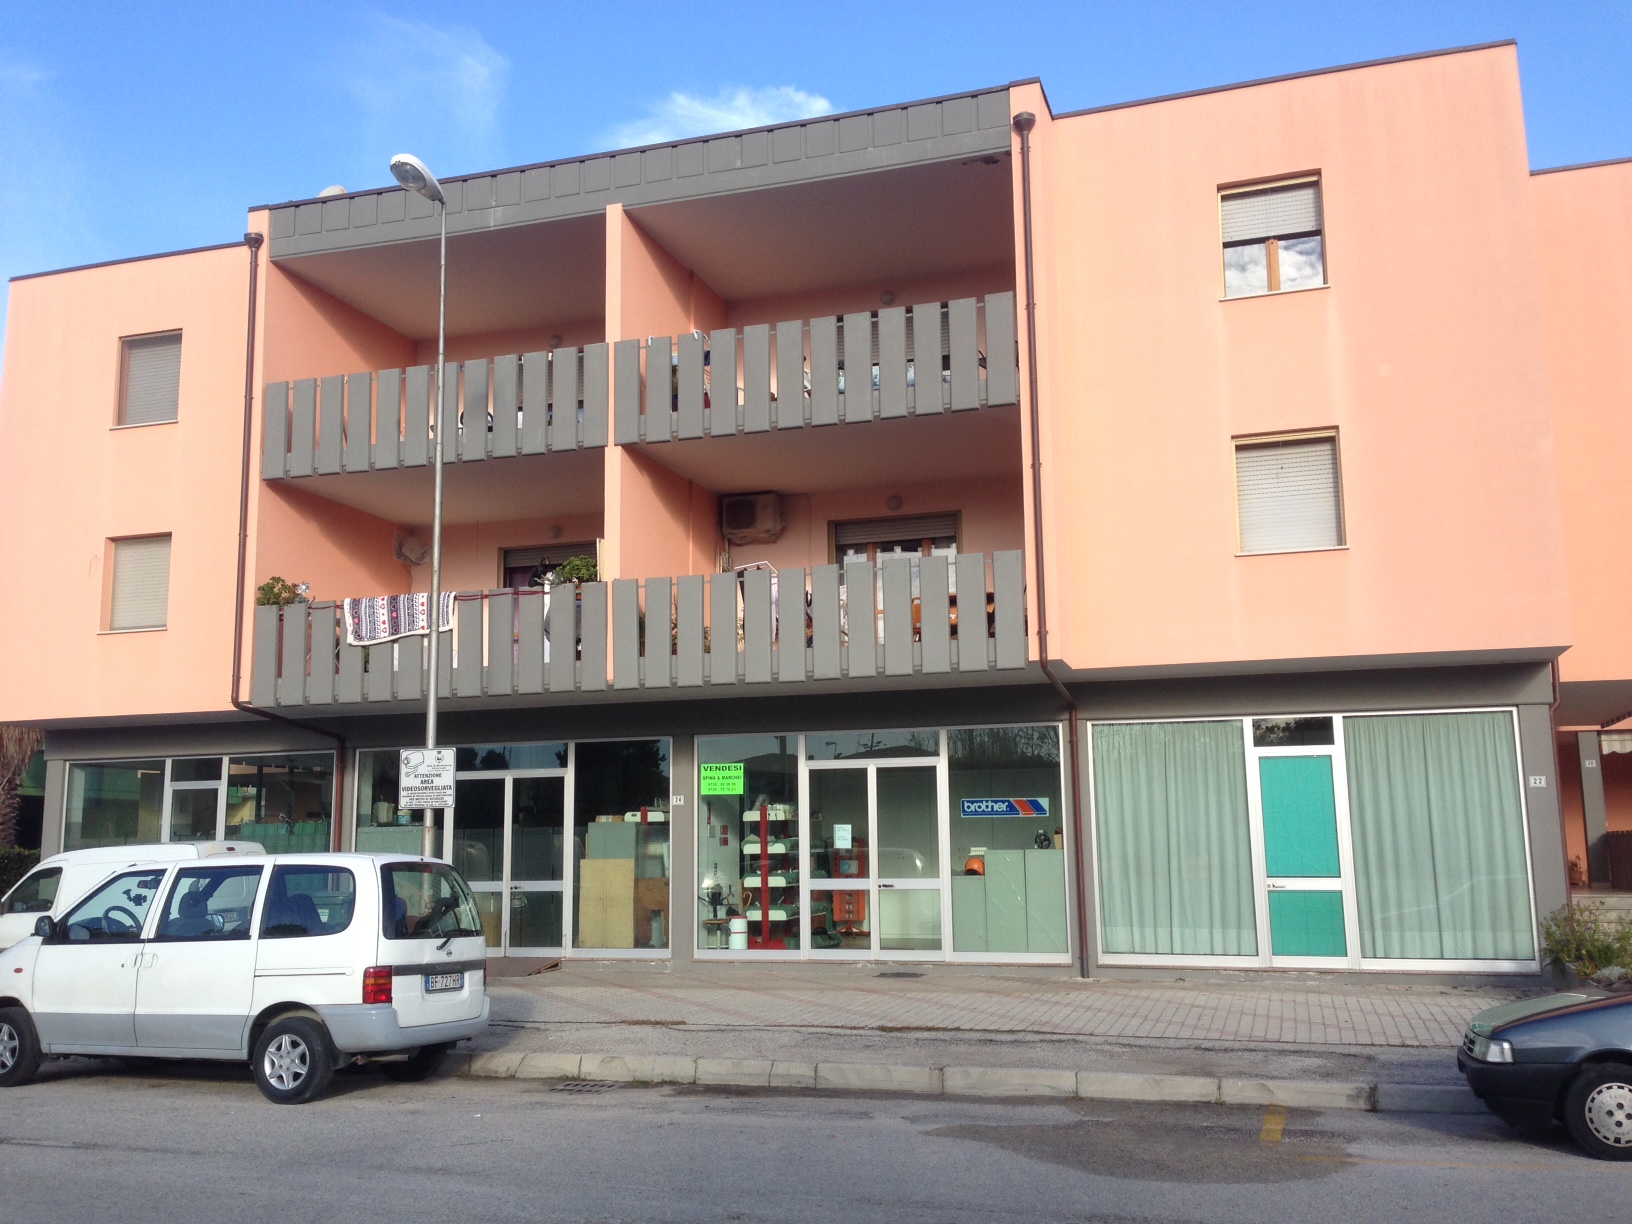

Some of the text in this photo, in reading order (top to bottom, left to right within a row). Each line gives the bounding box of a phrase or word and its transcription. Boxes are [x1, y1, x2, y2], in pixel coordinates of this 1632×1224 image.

[1533, 777, 1543, 785] 22
[964, 801, 1008, 812] brother
[430, 976, 439, 989] BF
